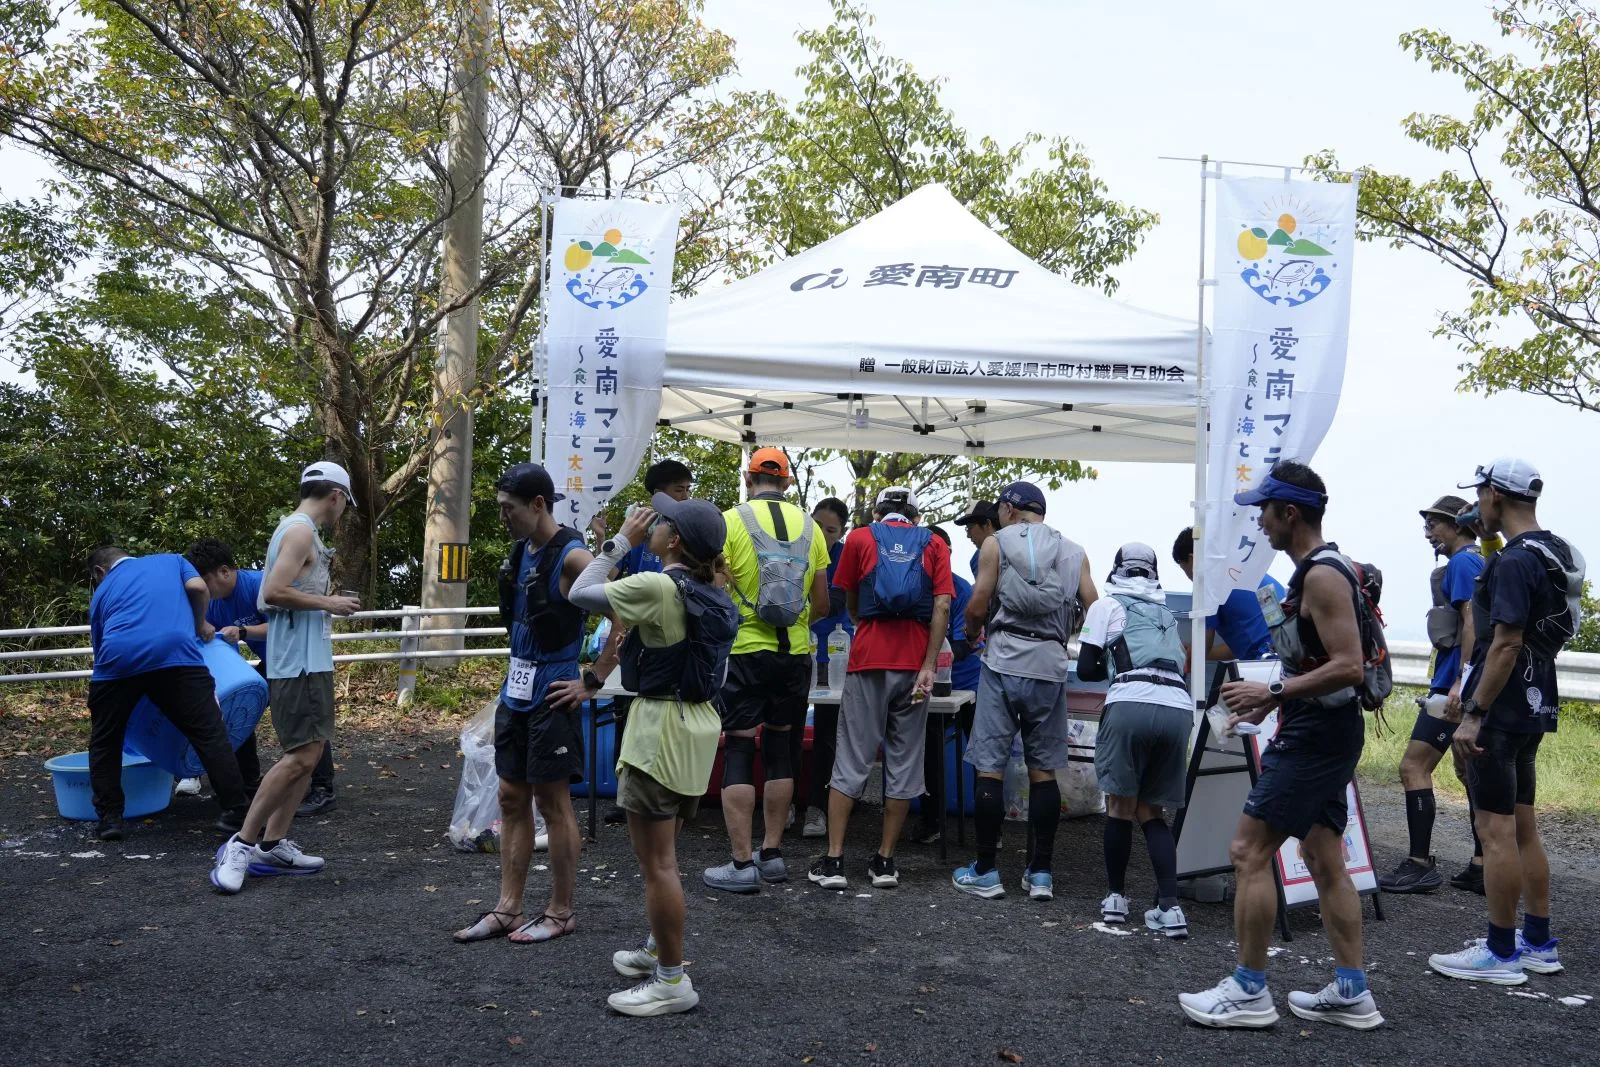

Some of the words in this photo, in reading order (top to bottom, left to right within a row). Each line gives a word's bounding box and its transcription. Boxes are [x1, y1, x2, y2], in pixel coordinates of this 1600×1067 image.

[862, 262, 1020, 290] 愛南町
[859, 357, 876, 373] 贈
[884, 358, 1185, 382] 一般財団法人愛媛県市町村職員互助会
[511, 670, 530, 686] 425
